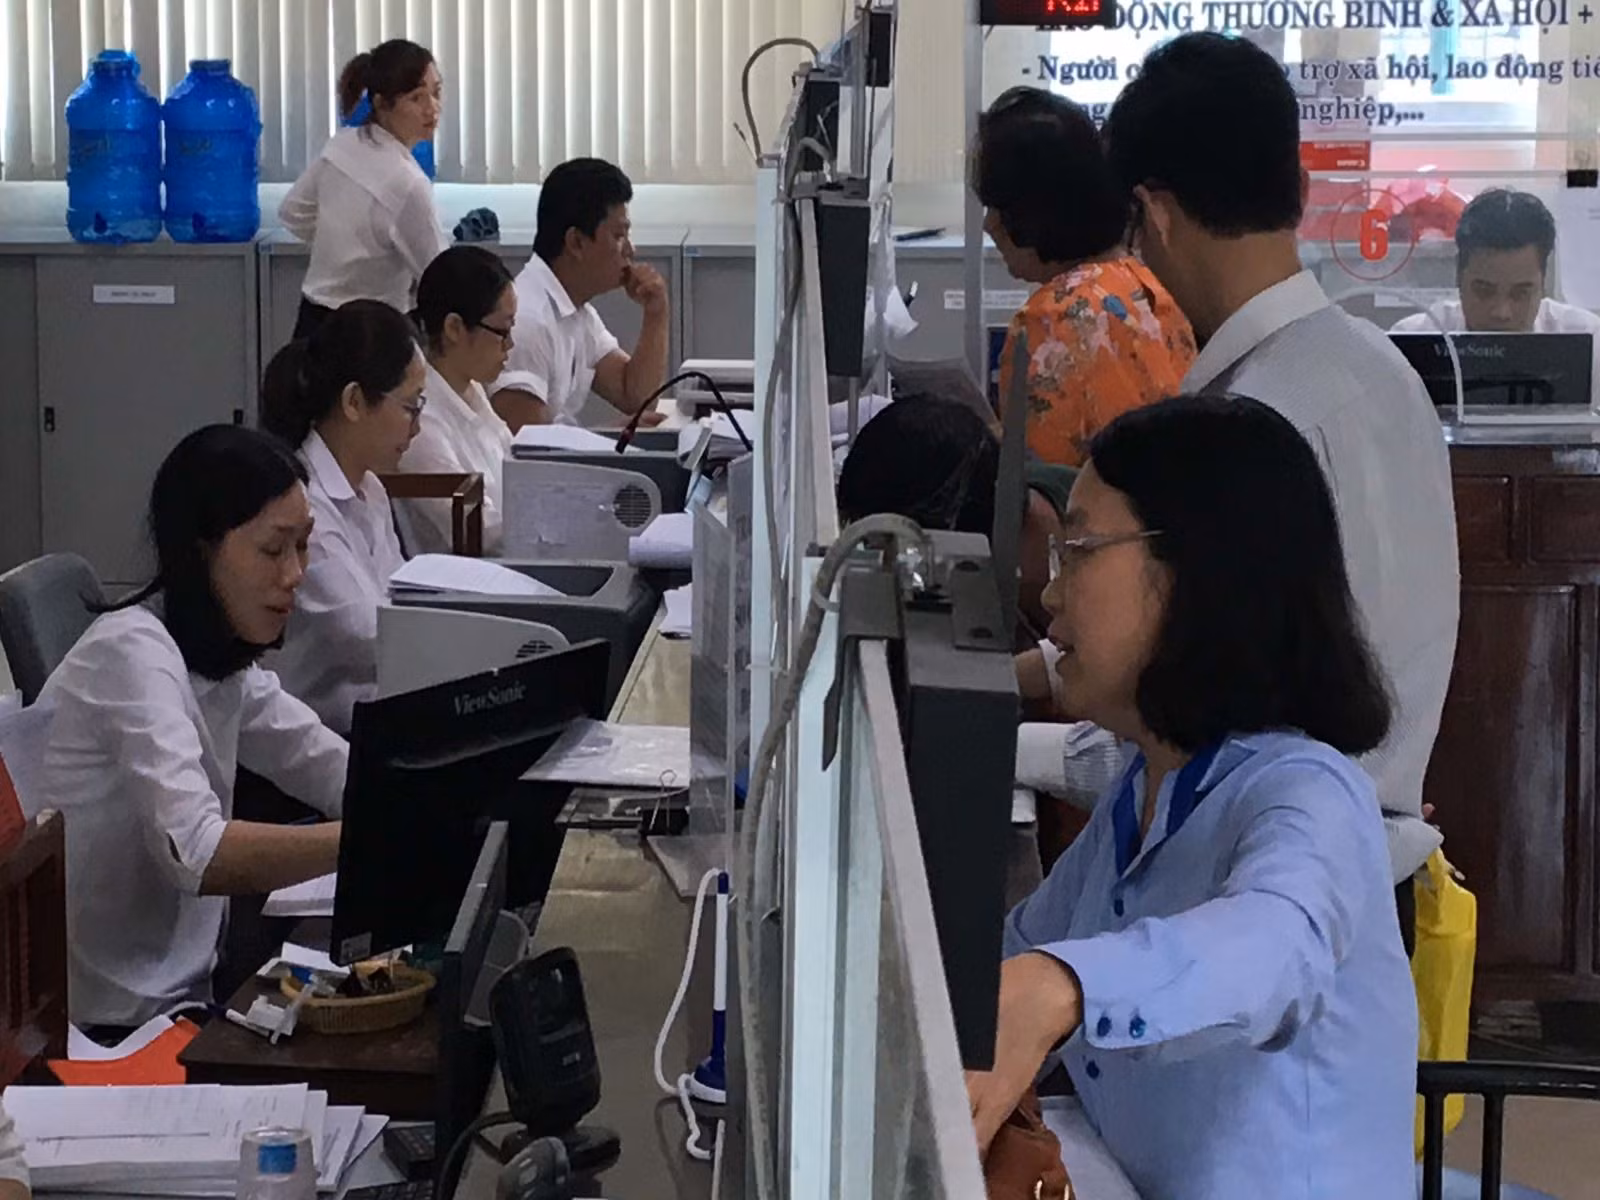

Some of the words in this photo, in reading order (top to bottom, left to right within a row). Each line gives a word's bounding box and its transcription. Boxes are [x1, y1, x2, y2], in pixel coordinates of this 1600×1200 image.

[1431, 0, 1454, 27] &
[1037, 54, 1119, 85] Người
[1300, 60, 1340, 86] trợ
[1347, 56, 1379, 80] xã
[1387, 54, 1439, 85] hội,
[1445, 54, 1488, 79] lao
[1495, 53, 1564, 85] động
[1360, 208, 1389, 261] 6
[454, 680, 527, 716] ViewSonic
